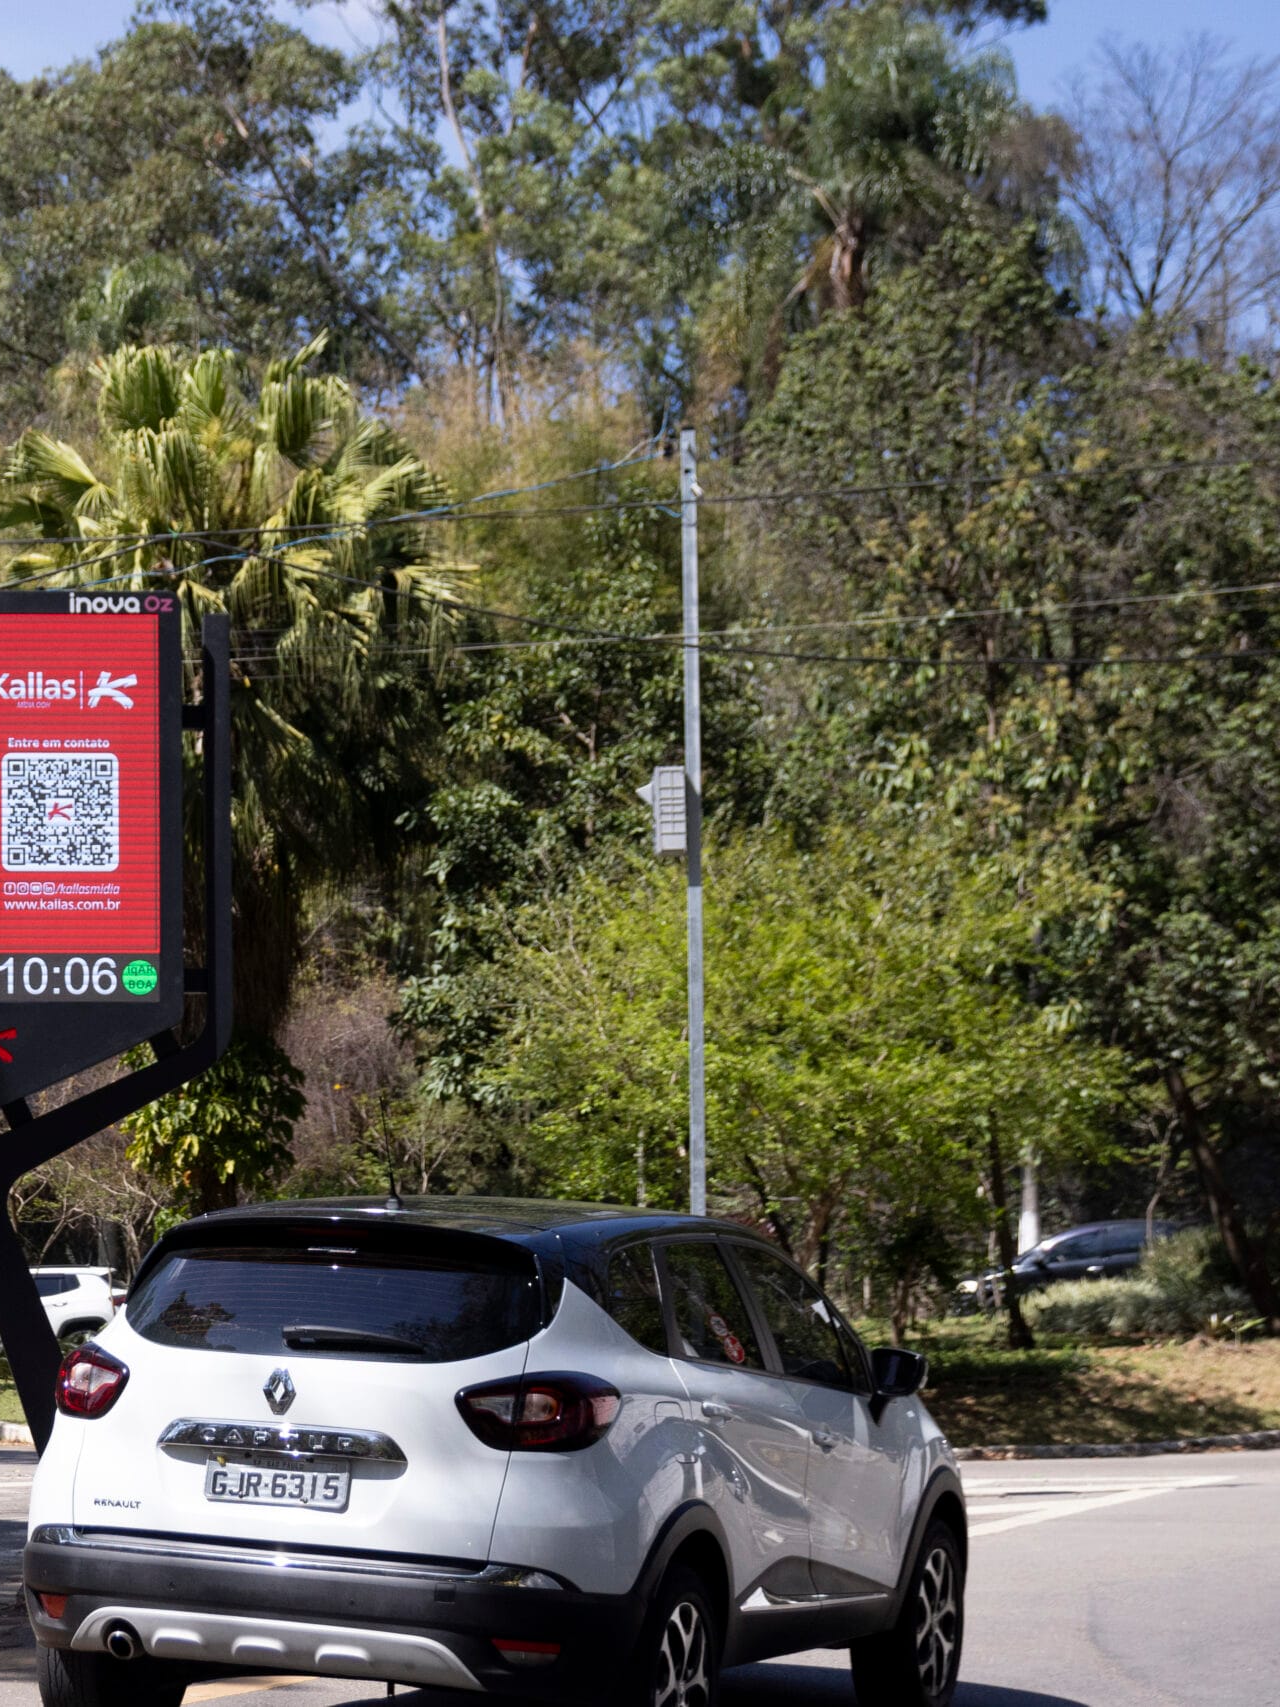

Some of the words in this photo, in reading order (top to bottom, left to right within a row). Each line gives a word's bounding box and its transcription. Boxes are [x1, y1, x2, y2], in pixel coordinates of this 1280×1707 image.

[70, 593, 140, 614] inova
[8, 737, 39, 748] Entre
[42, 740, 61, 748] em
[64, 738, 110, 748] contato
[4, 899, 120, 910] www.kallas.com.br
[128, 979, 153, 989] BOA
[94, 1498, 141, 1509] RENAULT
